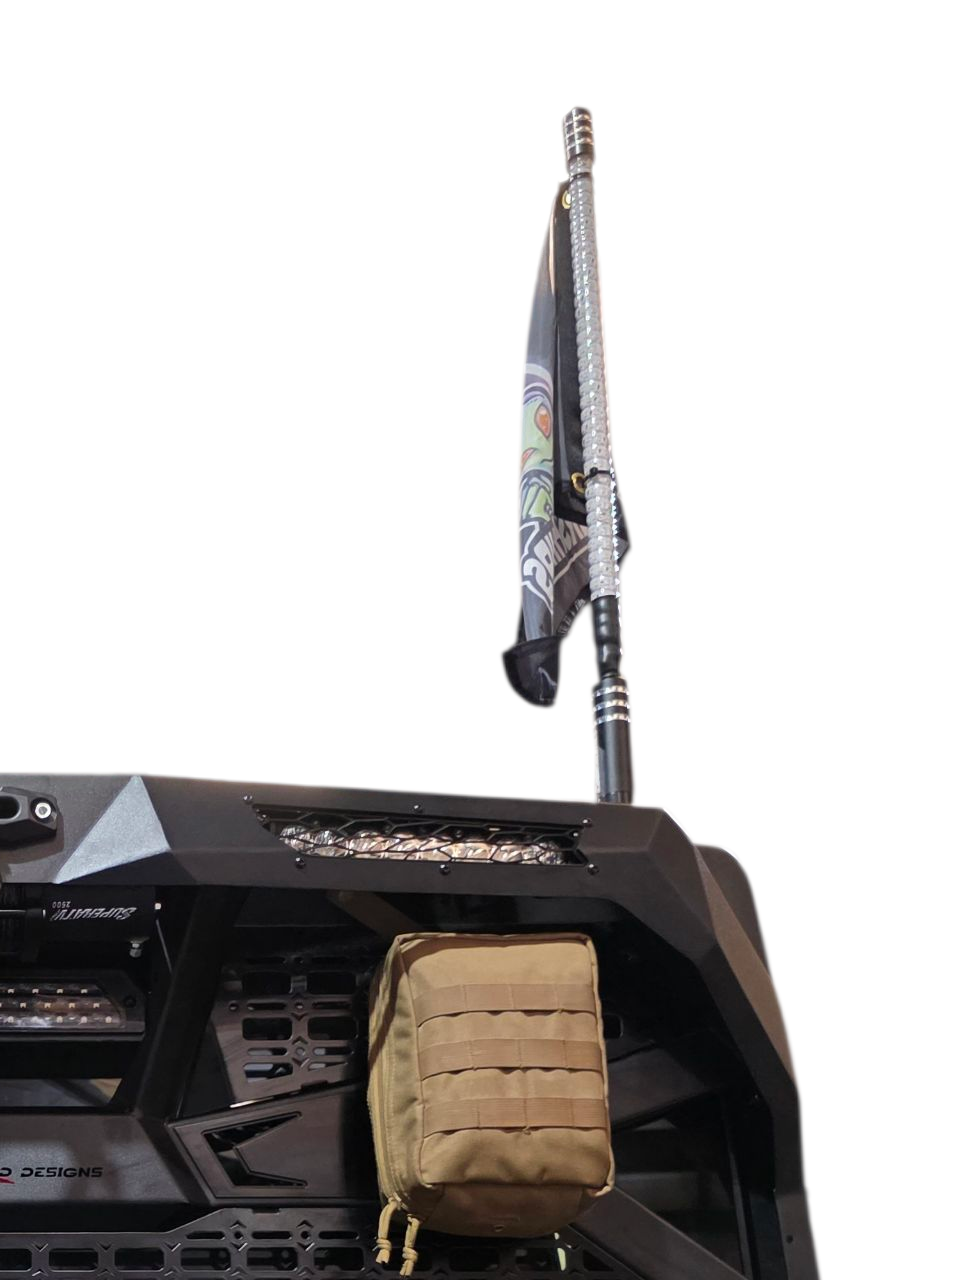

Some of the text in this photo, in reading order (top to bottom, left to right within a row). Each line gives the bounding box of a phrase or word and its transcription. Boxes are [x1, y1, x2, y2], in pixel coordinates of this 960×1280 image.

[51, 901, 71, 909] 2500
[49, 907, 137, 922] SUPERATV
[20, 1166, 103, 1178] DESIGNS
